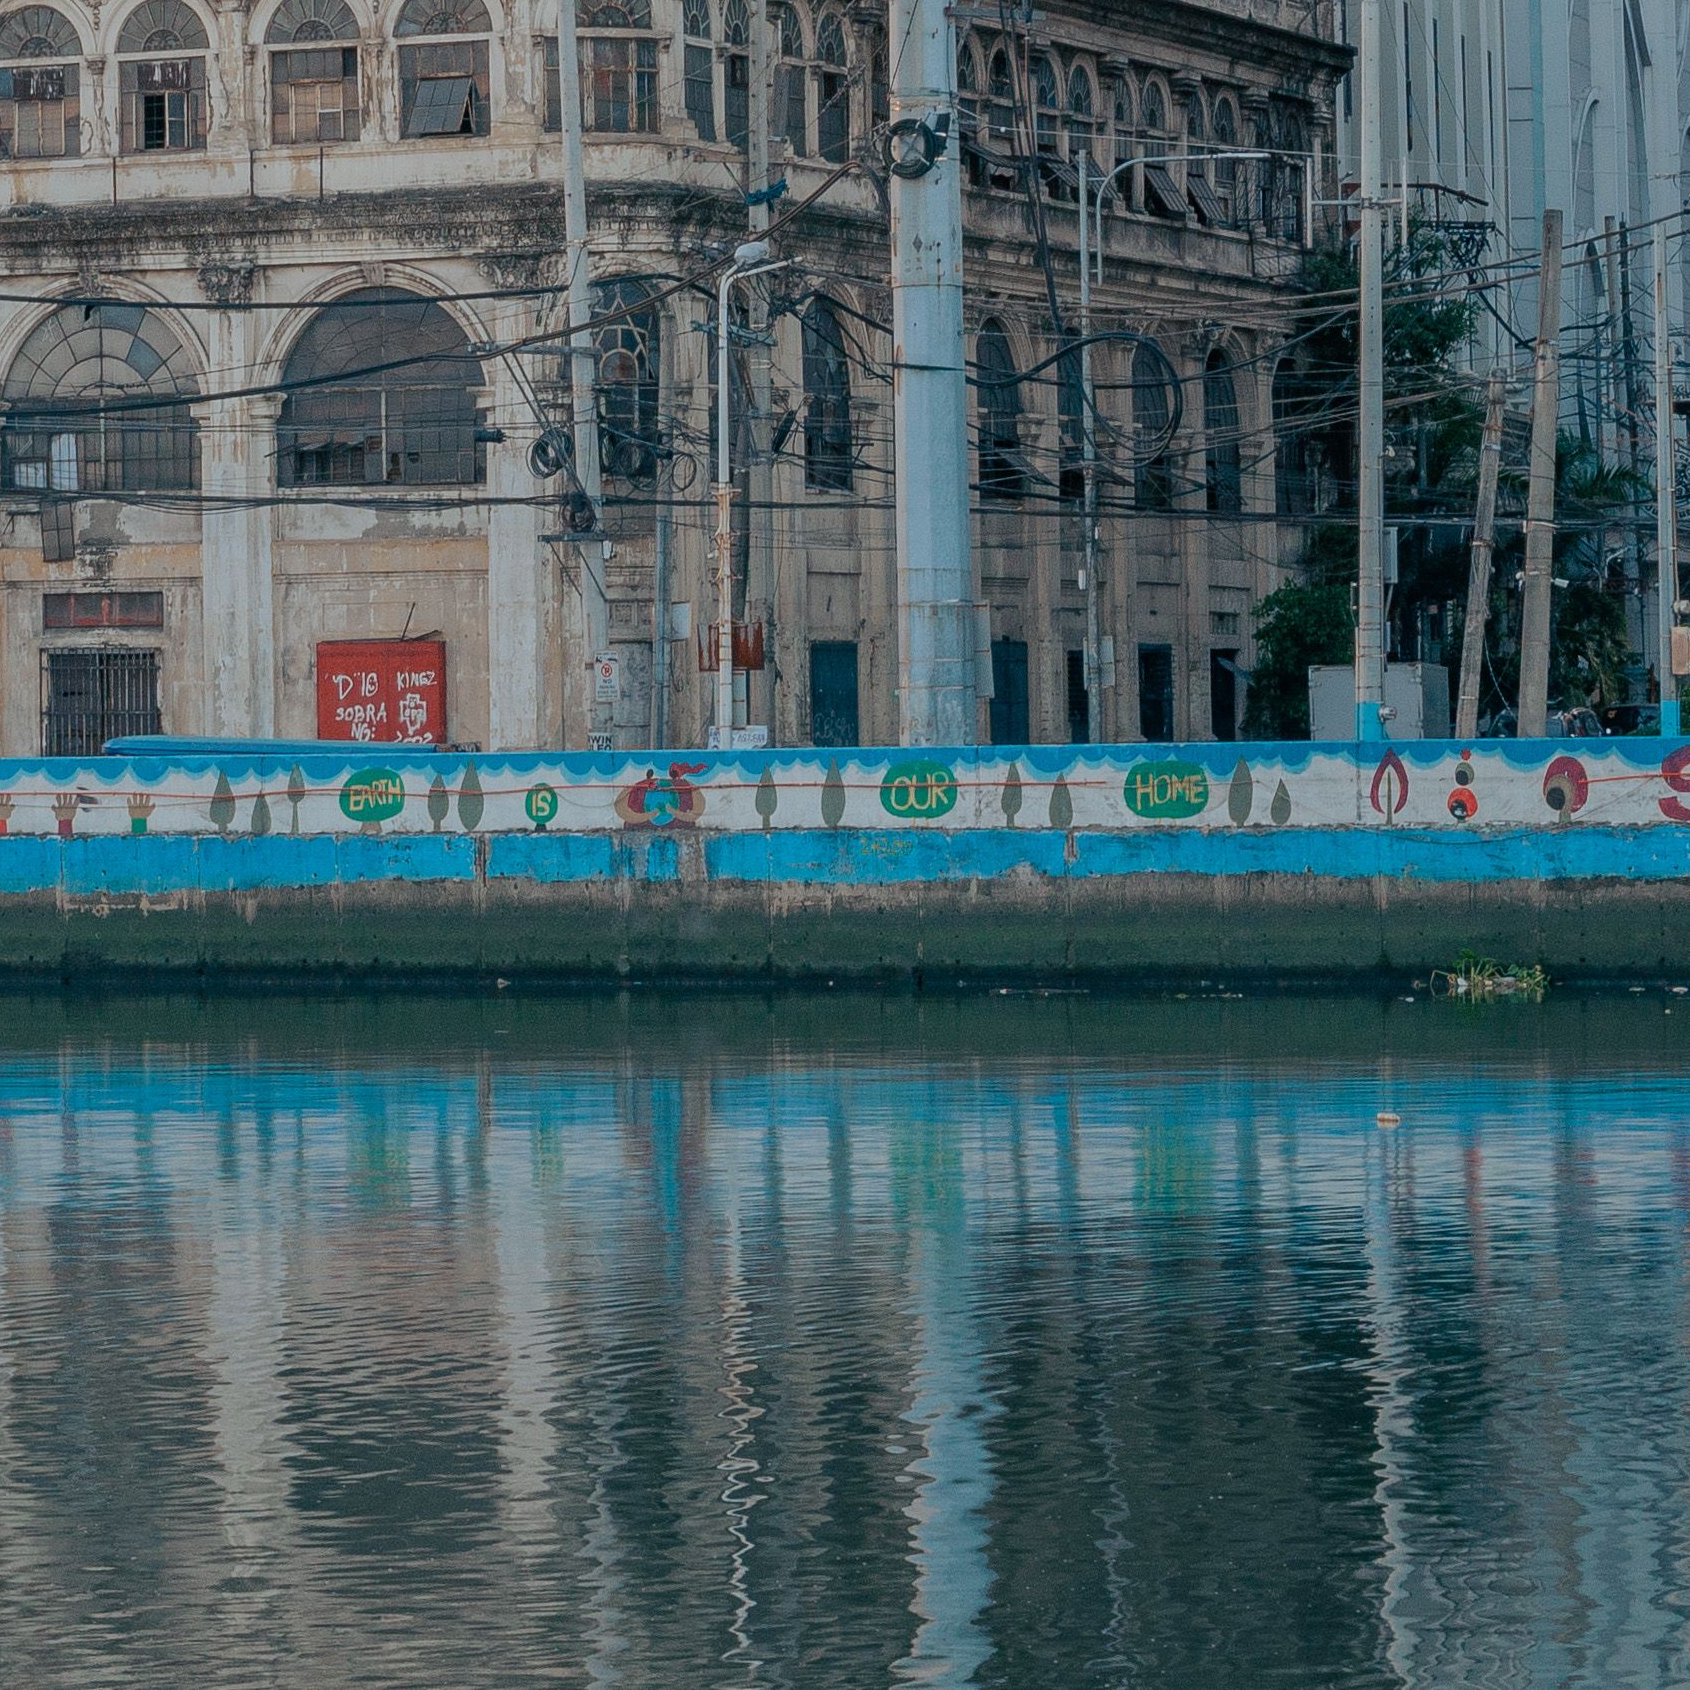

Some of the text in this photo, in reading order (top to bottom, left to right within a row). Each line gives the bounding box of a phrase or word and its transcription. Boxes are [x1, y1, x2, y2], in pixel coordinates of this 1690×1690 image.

[335, 702, 387, 723] SOBRA
[349, 771, 1205, 816] EARTH IS OUR HOME
